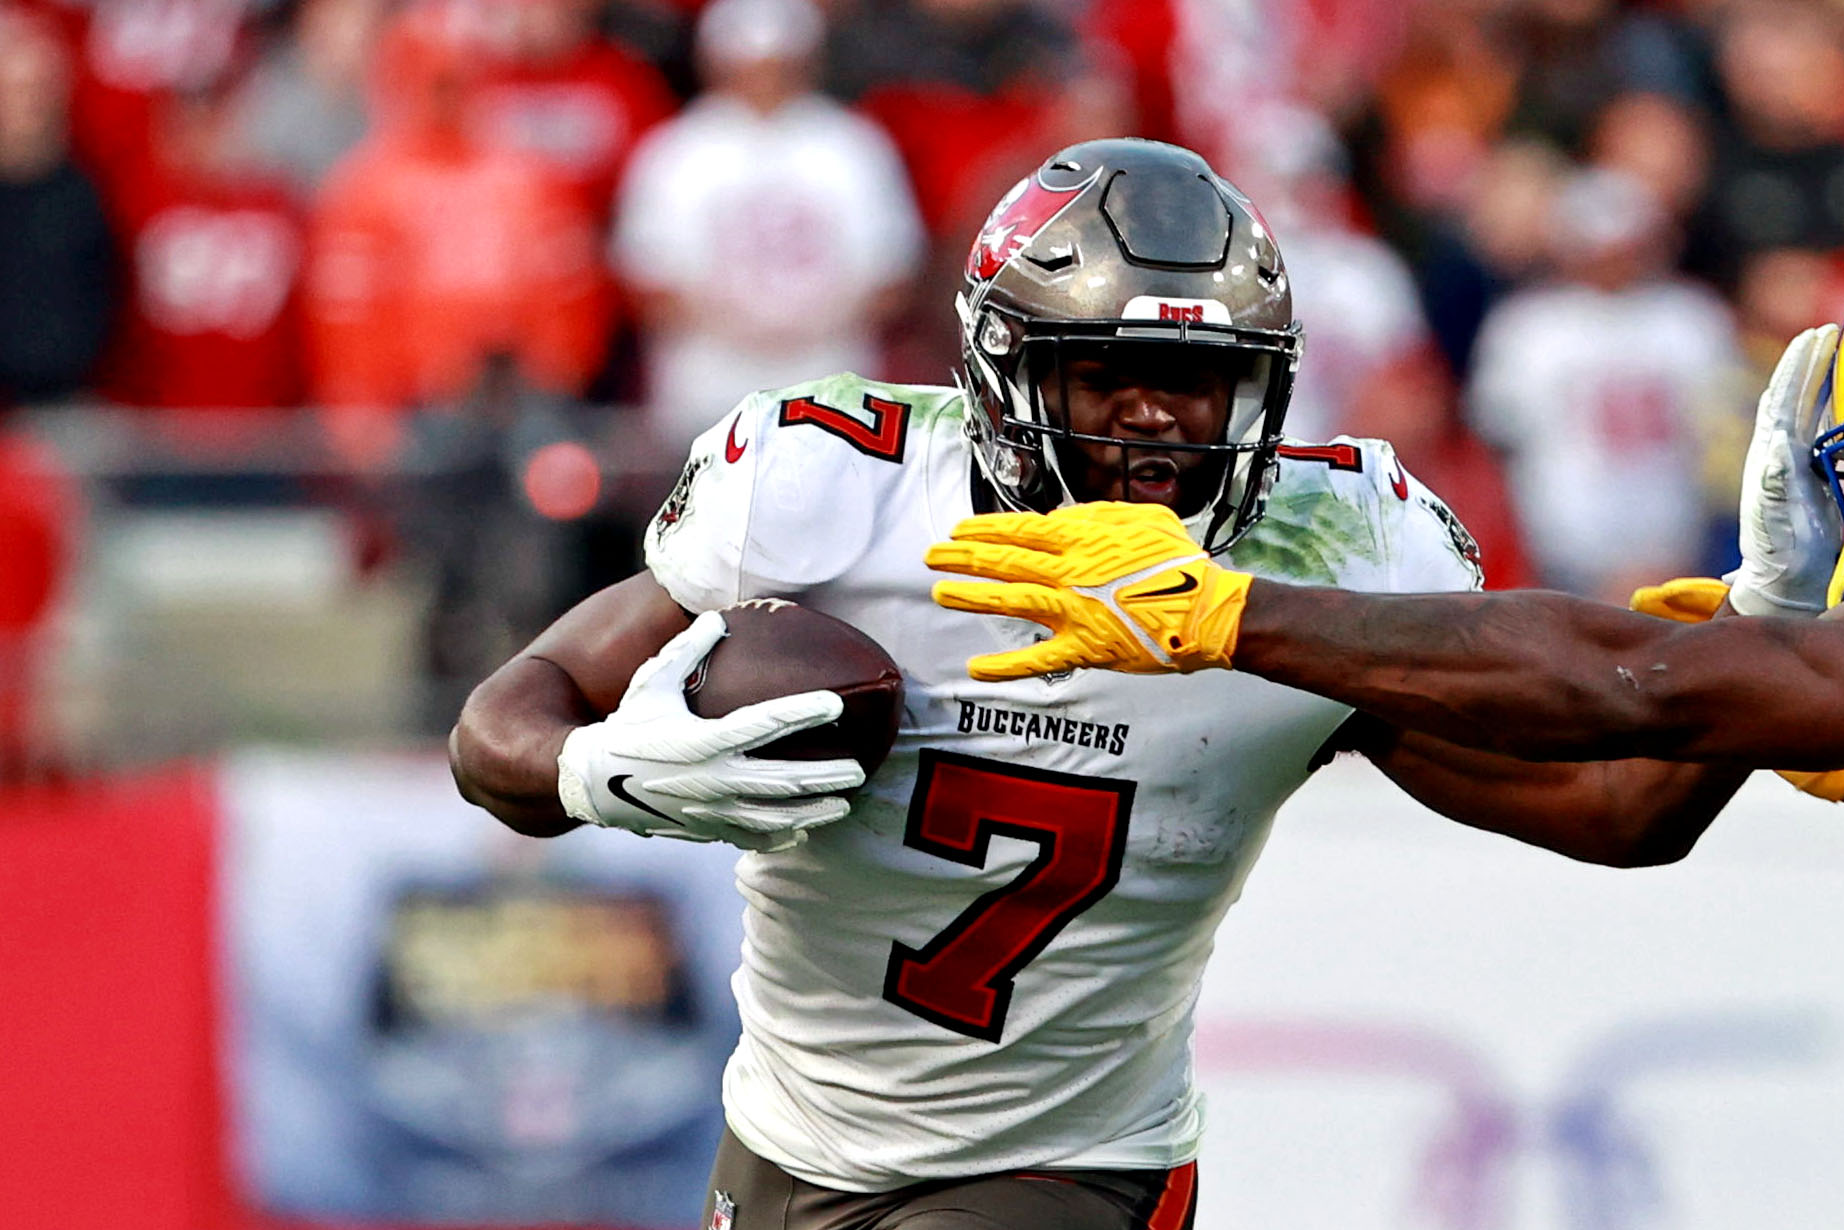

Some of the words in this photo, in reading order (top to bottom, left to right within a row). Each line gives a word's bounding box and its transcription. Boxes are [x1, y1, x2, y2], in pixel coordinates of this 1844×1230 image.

[779, 393, 912, 464] 7
[957, 700, 1130, 756] BUCCANEERS
[883, 748, 1137, 1044] 7
